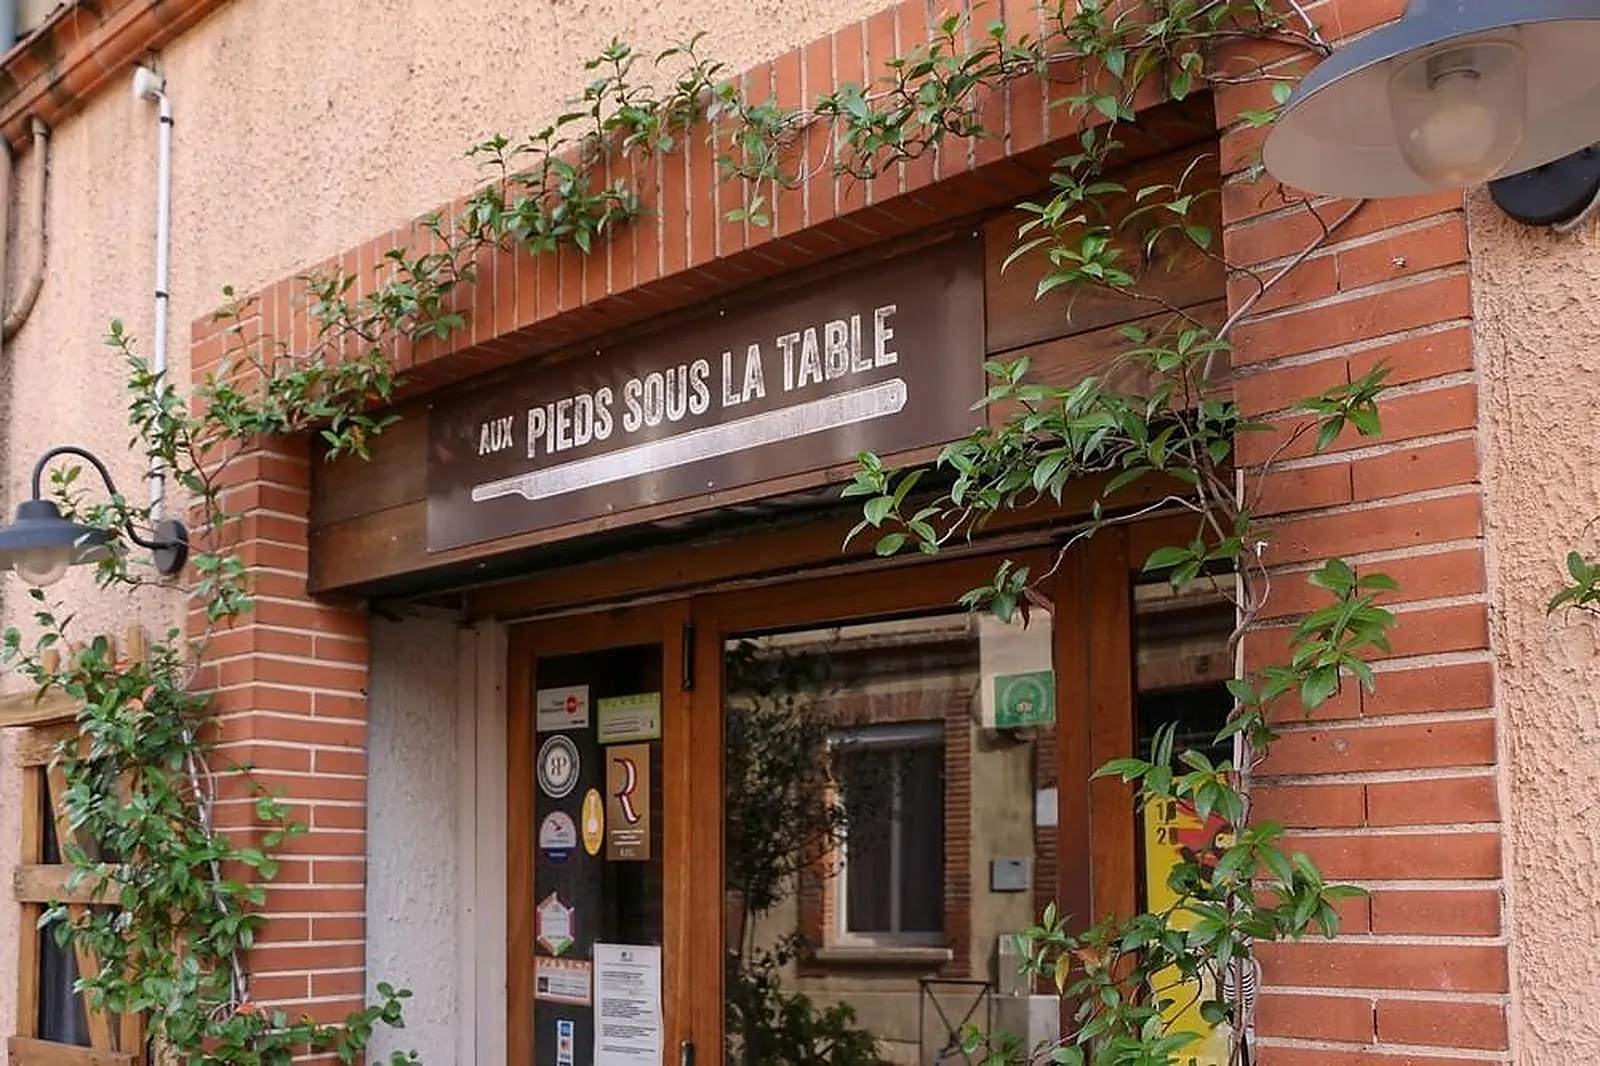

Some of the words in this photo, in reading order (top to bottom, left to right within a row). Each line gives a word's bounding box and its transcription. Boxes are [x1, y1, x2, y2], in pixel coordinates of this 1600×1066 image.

[479, 416, 513, 455] AUX
[527, 387, 613, 458] PIEDS
[623, 359, 710, 432] SOUS
[722, 344, 765, 406] LA
[777, 305, 898, 391] TABLE
